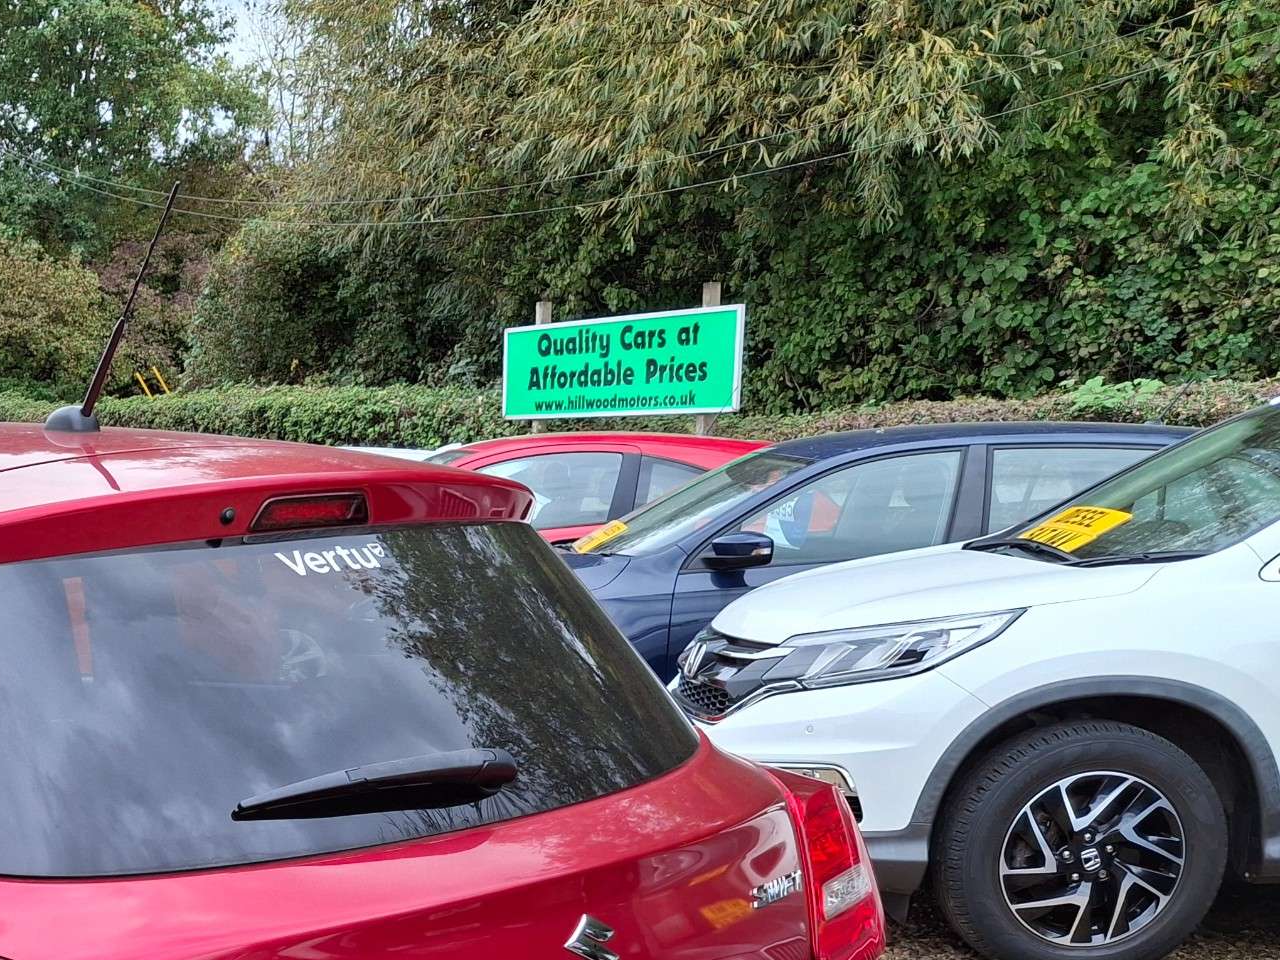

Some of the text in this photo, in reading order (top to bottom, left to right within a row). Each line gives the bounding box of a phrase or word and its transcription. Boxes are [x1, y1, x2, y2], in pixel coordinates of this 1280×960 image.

[537, 322, 700, 358] Quality Cars at
[528, 356, 708, 390] Affordable Prices
[534, 390, 696, 412] www.hillwoodmotors.co.uk
[274, 545, 382, 576] Vertu
[751, 870, 803, 909] SWIFT
